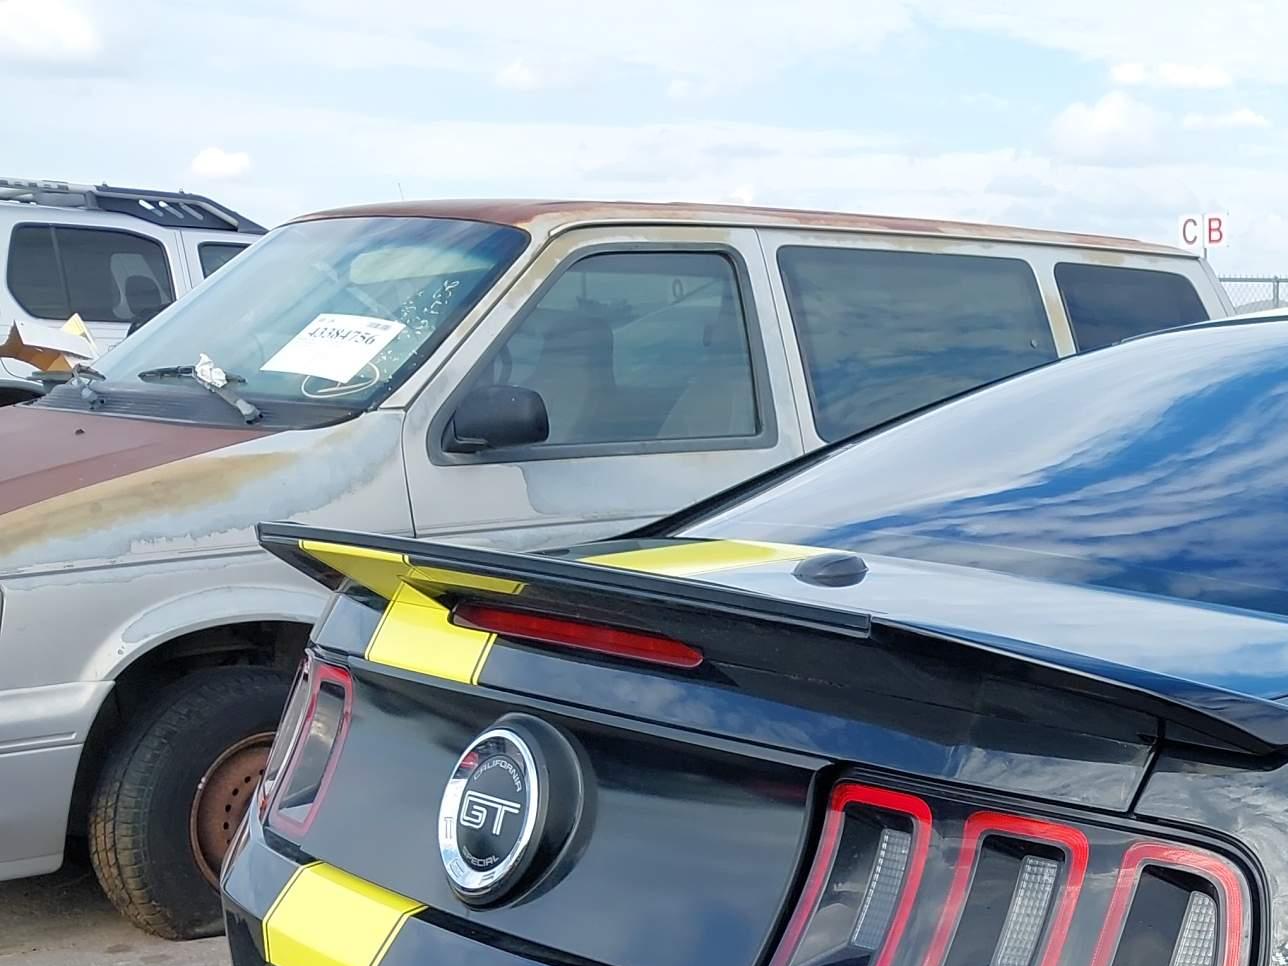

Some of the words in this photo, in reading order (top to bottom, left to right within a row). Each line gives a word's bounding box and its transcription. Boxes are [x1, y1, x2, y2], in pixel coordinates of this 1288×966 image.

[1182, 218, 1198, 245] C
[1208, 217, 1223, 243] B
[473, 759, 522, 793] CALIFORNIA
[460, 790, 521, 836] GT
[462, 845, 500, 867] SPECIAL
